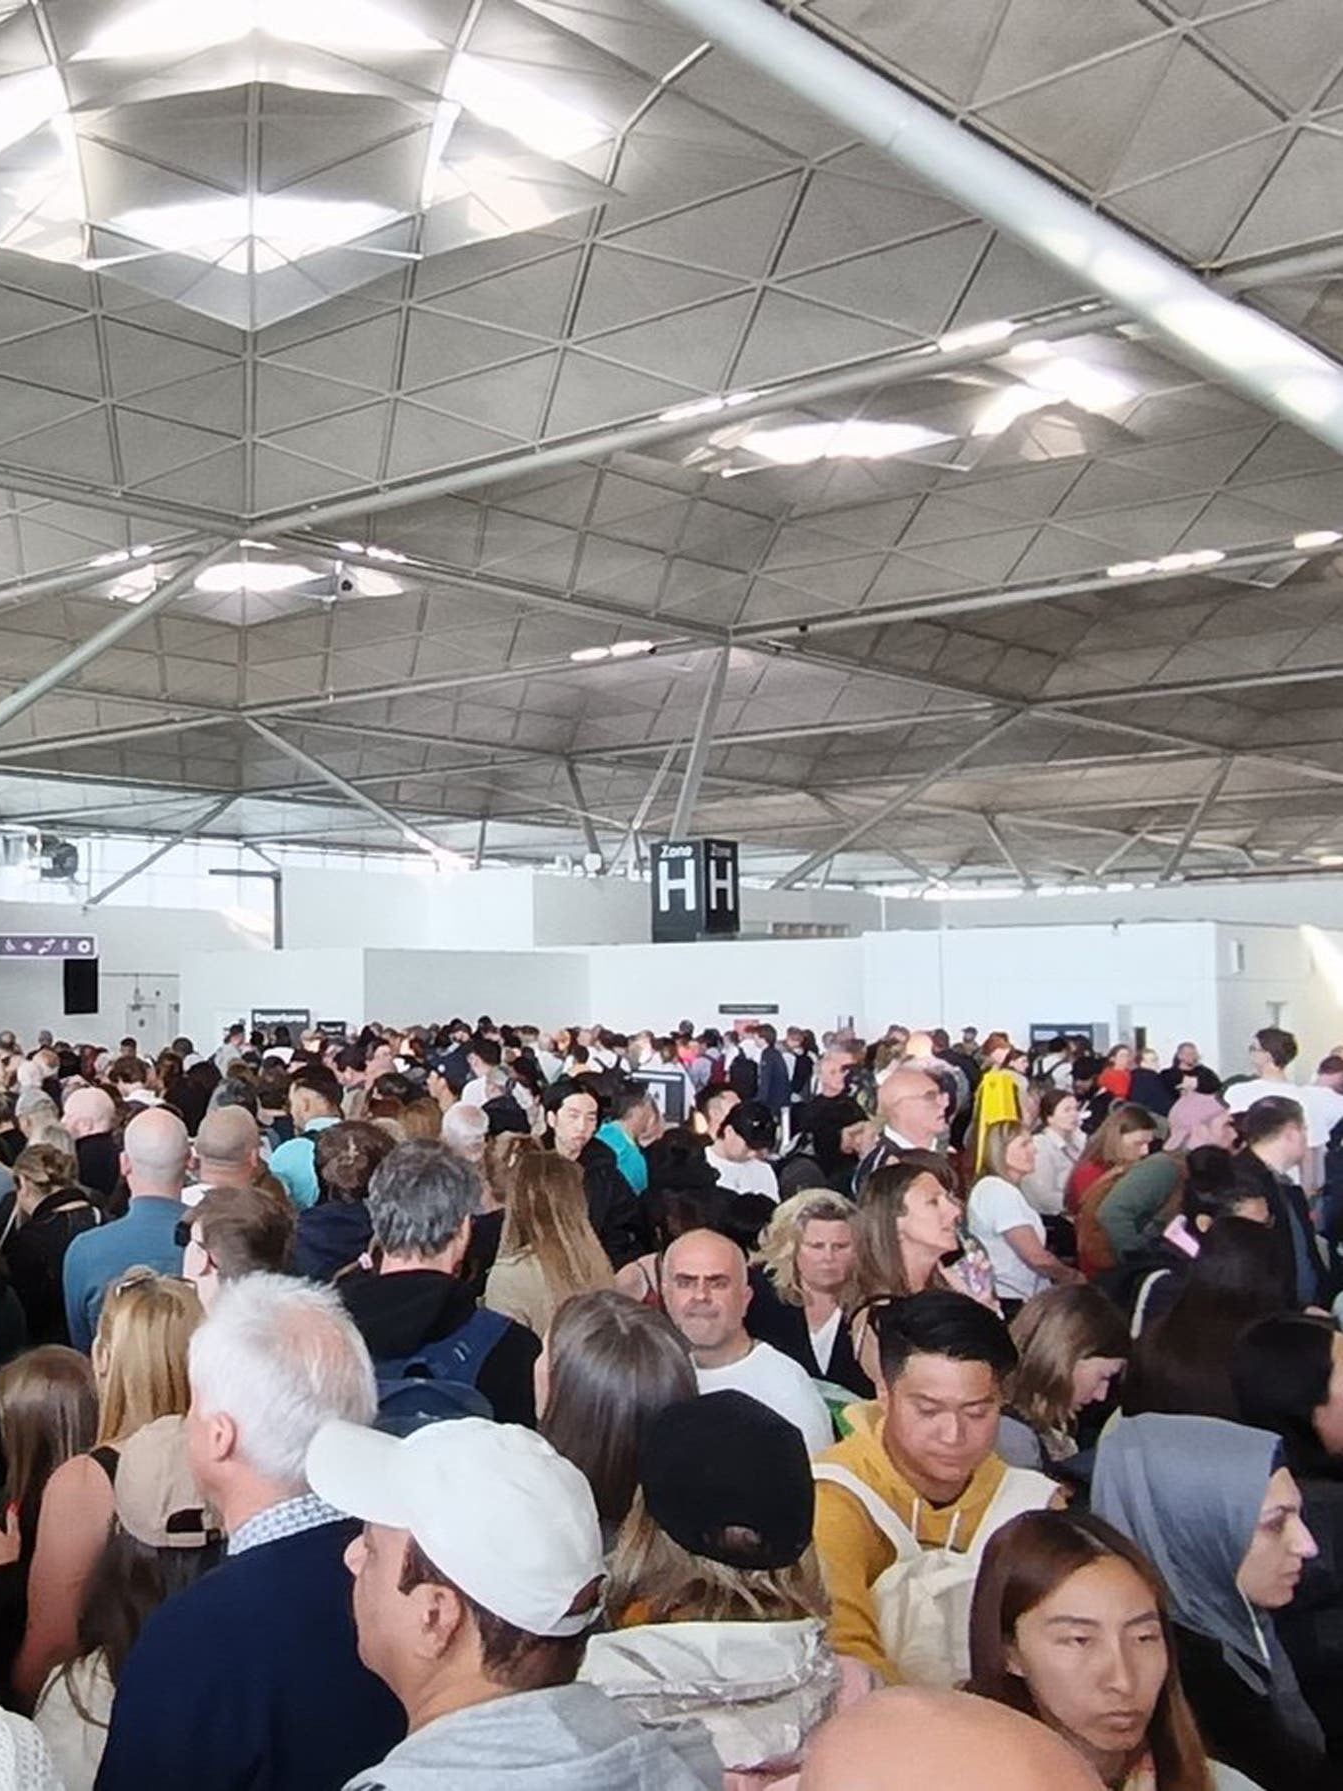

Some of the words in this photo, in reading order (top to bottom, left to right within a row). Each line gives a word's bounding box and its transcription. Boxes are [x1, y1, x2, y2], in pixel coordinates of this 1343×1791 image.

[659, 844, 693, 859] Zone
[658, 859, 695, 911] H
[709, 858, 734, 911] H
